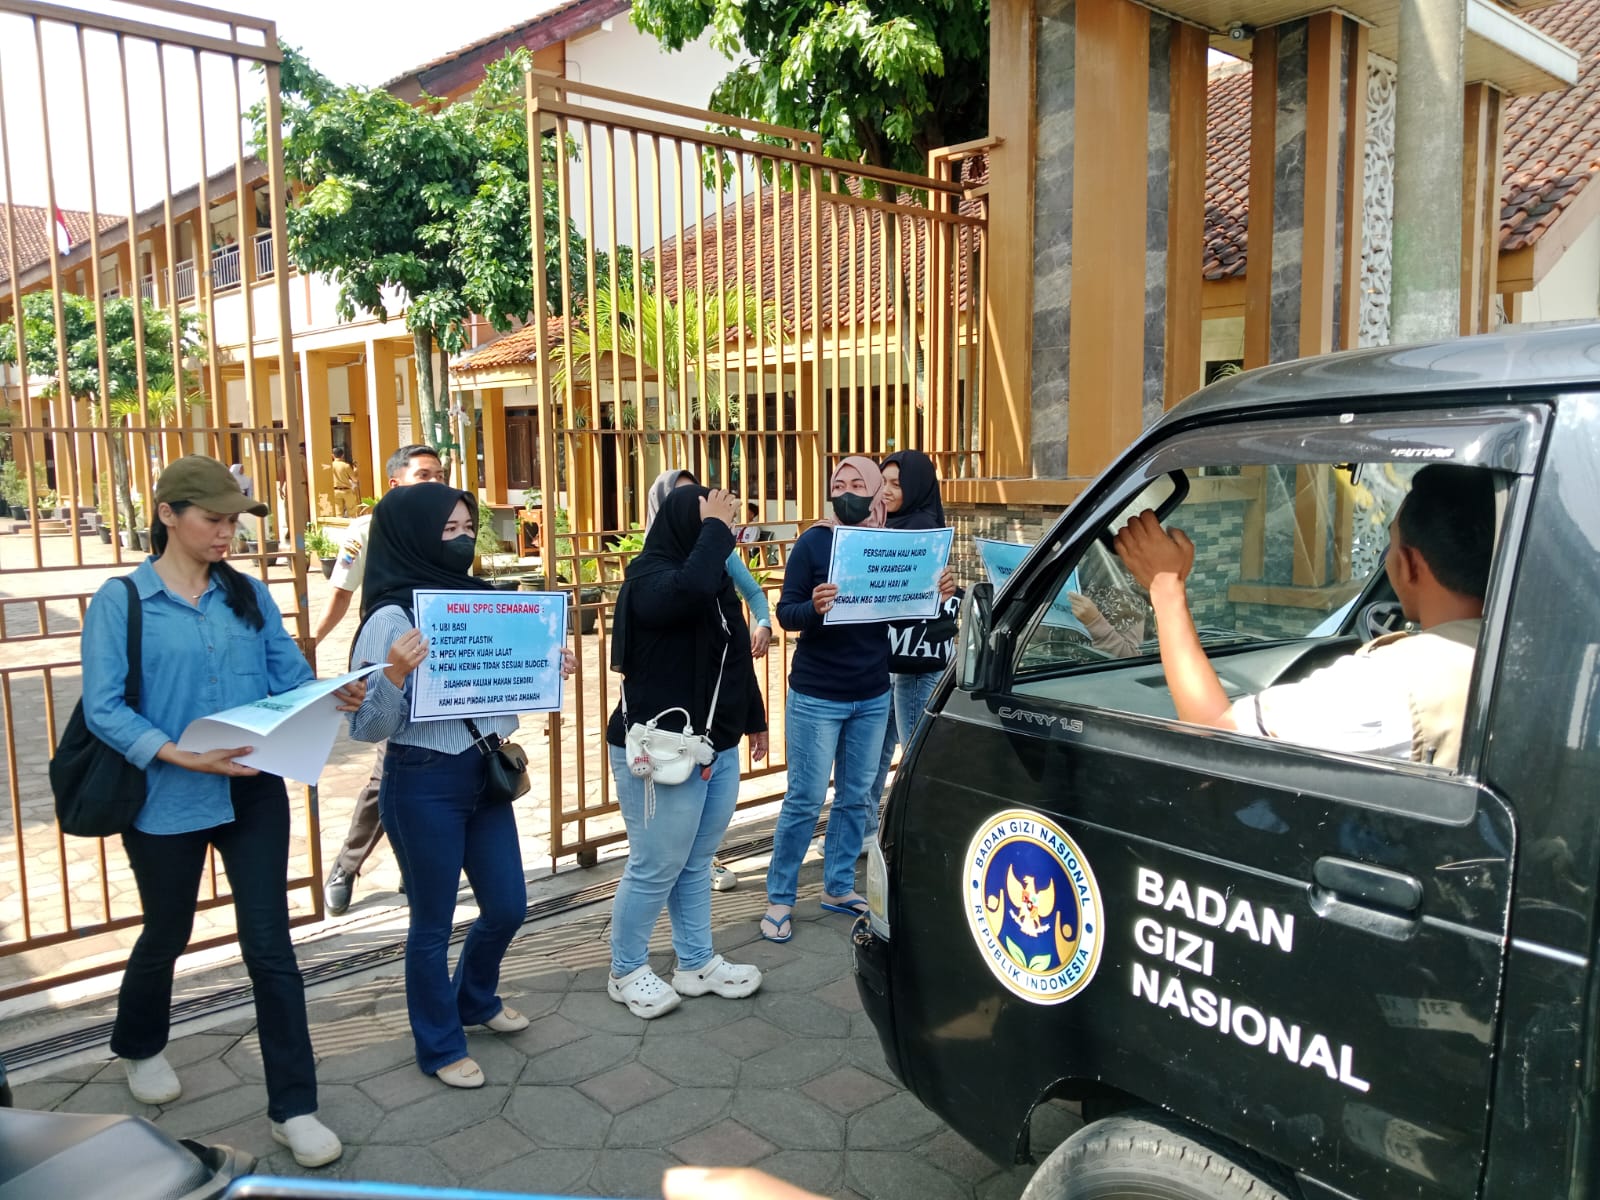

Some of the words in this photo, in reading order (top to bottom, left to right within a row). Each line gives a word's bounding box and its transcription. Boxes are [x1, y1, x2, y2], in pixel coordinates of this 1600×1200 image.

[863, 549, 896, 558] PERSATUAN
[898, 549, 910, 558] WALI
[911, 548, 927, 557] MURID
[867, 565, 879, 573] SDN
[880, 565, 912, 573] KRANDEGAN
[870, 580, 886, 589] MULAI
[888, 580, 900, 588] HARI
[901, 580, 909, 588] INI
[834, 595, 859, 604] MENOLAK
[860, 594, 872, 604] MBG
[874, 594, 887, 603] DARI
[887, 594, 901, 603] SPPG
[447, 603, 470, 614] MENU
[473, 603, 493, 613] SPPG
[496, 604, 540, 614] SEMARANG
[440, 623, 450, 631] UBI
[452, 622, 466, 631] BASI
[432, 637, 438, 645] 2.
[440, 636, 467, 645] KETUPAT
[468, 636, 493, 644] PLASTIK
[440, 650, 457, 659] MPEK
[458, 649, 475, 658] MPEK
[477, 649, 493, 657] KUAH
[495, 648, 512, 656] LALAT
[430, 664, 436, 672] 4.
[439, 662, 457, 671] MENU
[459, 662, 481, 671] KERING
[483, 661, 500, 670] TIDAK
[502, 660, 523, 669] SESUAI
[444, 679, 471, 688] SILAHKAN
[473, 678, 492, 687] KALIAN
[493, 677, 511, 686] MAKAN
[513, 677, 533, 685] SENDIRI
[454, 697, 466, 706] MAU
[467, 696, 486, 705] PINDAH
[487, 695, 504, 703] DAPUR
[505, 694, 518, 702] YANG
[519, 693, 540, 701] AMANAH
[999, 706, 1057, 727] CARRY
[1060, 717, 1084, 733] 1.5
[975, 826, 1006, 870] BADAN
[1010, 821, 1034, 835] GIZI
[1040, 827, 1091, 908] NASIONAL
[1136, 866, 1295, 953] BADAN
[974, 905, 1020, 981] REPUBLIK
[1026, 948, 1089, 991] INDONESIA
[1134, 917, 1215, 977] GIZI
[1132, 963, 1371, 1092] NASIONAL
